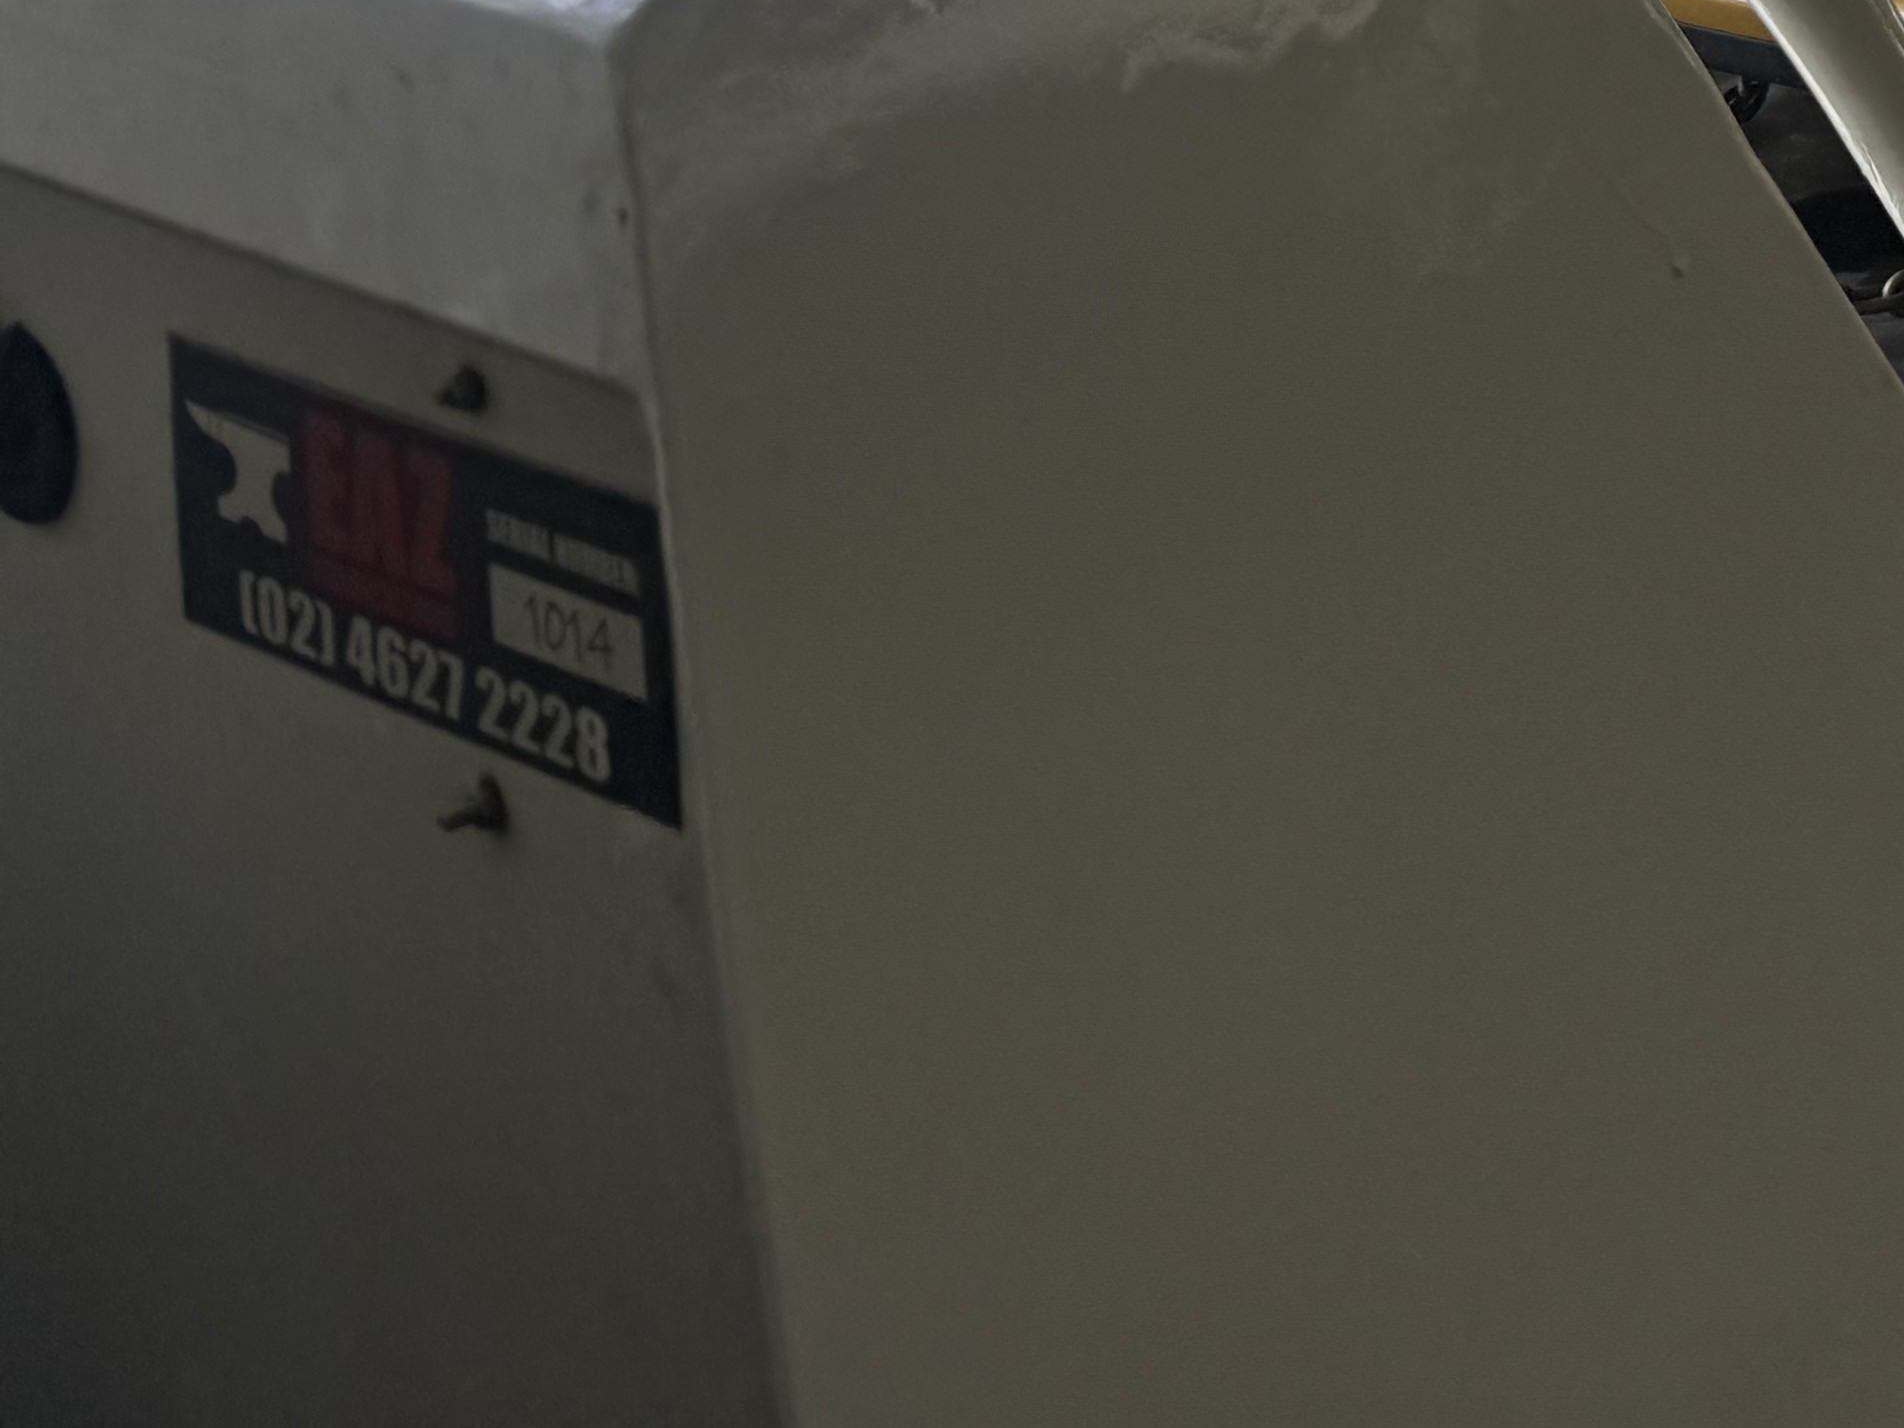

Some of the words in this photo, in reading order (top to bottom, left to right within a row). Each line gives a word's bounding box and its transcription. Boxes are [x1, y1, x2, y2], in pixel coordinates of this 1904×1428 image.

[523, 592, 614, 674] 1014
[345, 613, 466, 721] 4627
[475, 665, 612, 784] 2228
